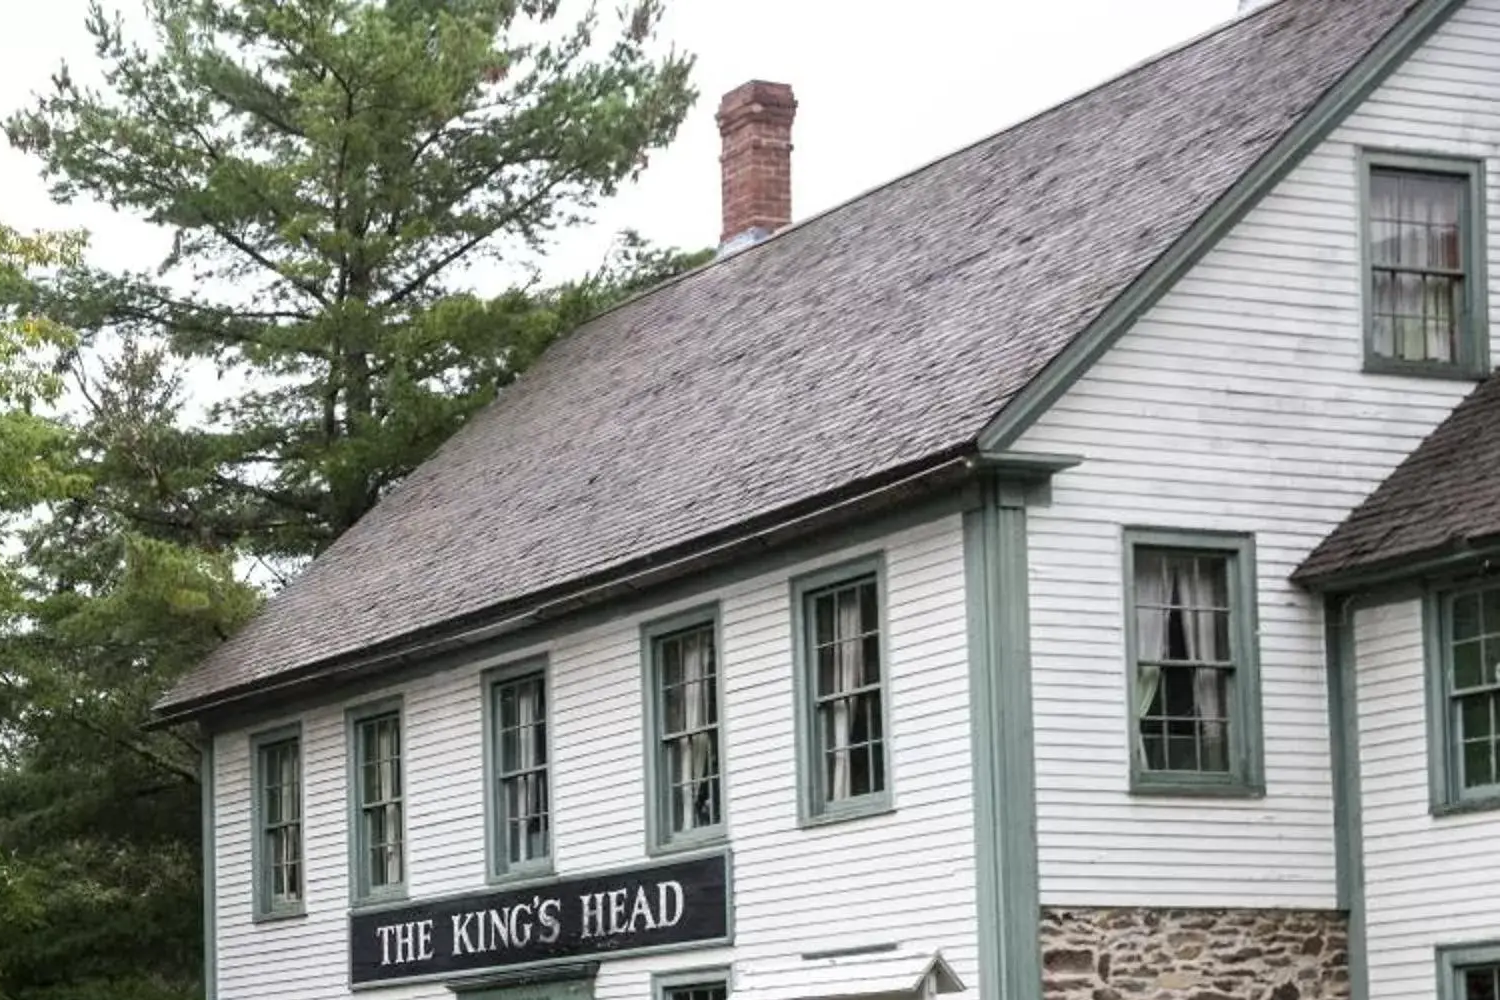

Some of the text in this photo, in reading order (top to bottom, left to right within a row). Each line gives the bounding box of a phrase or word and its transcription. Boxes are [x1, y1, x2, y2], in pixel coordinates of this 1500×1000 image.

[376, 880, 685, 966] THE KING'S HEAD
